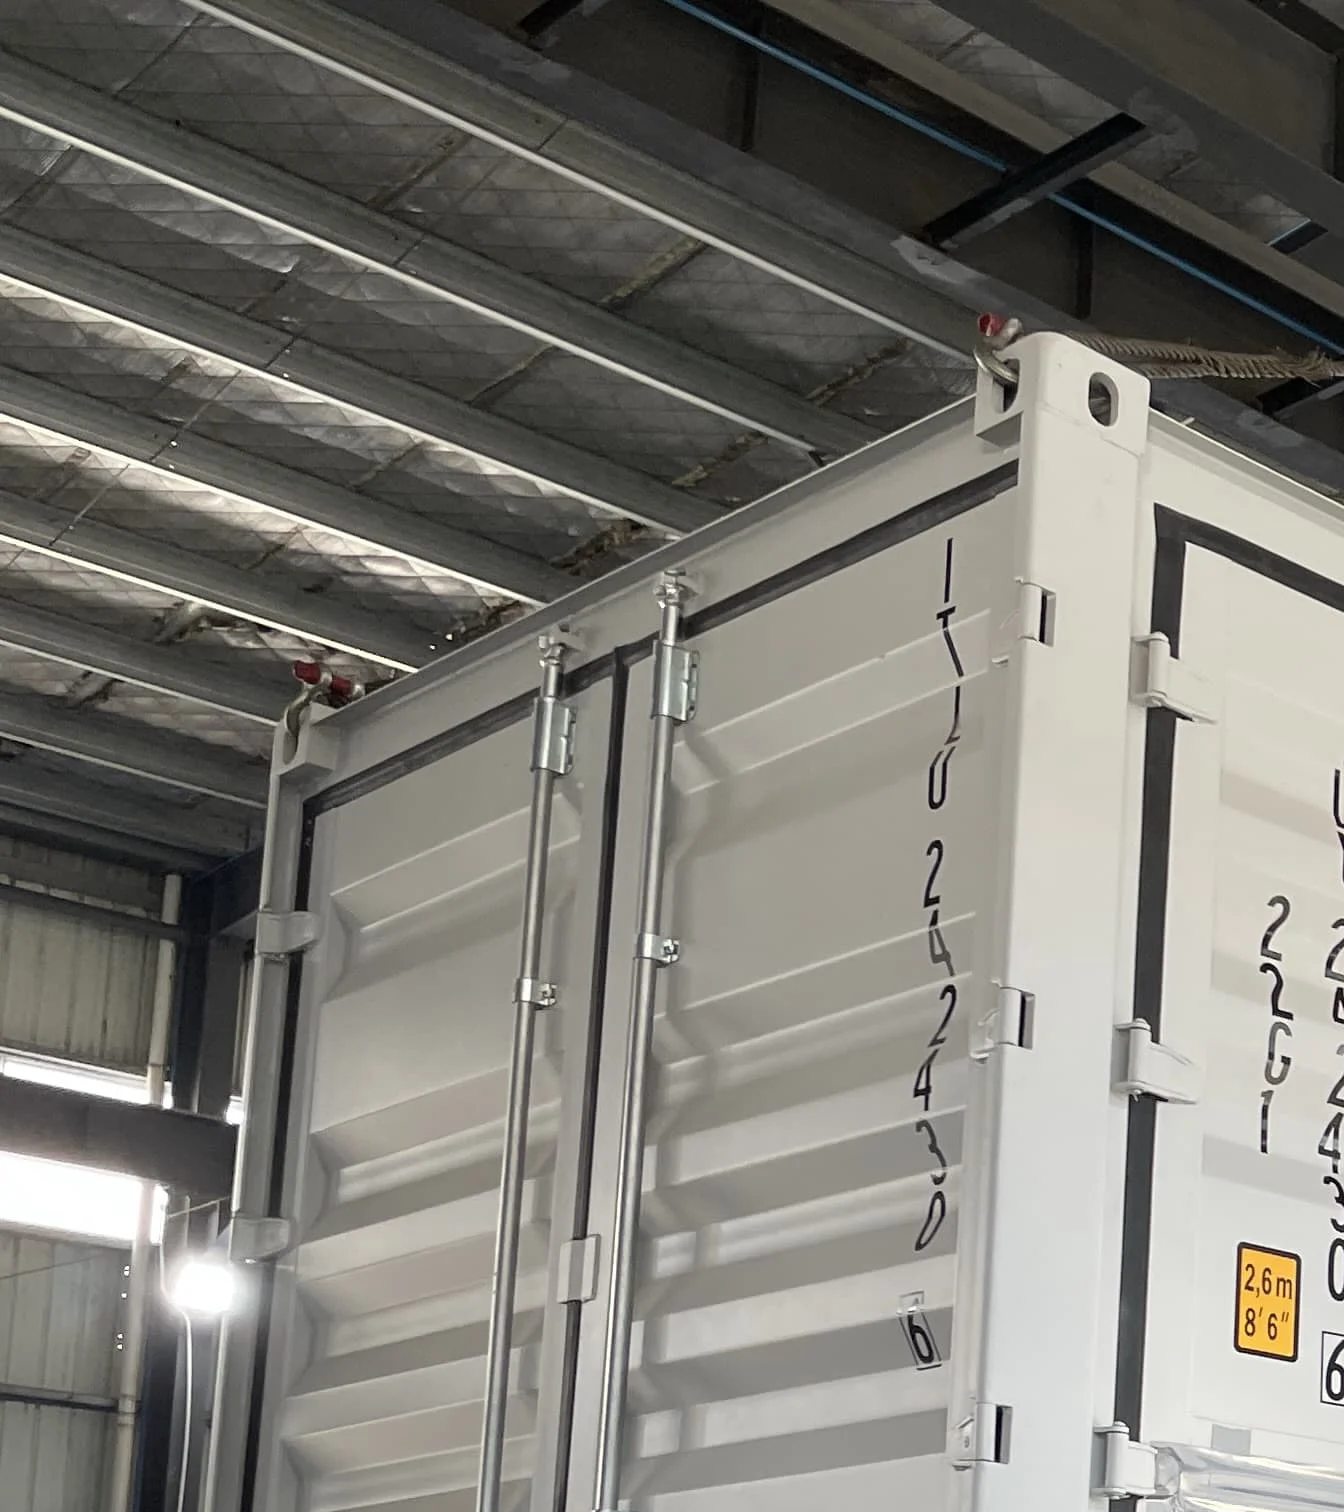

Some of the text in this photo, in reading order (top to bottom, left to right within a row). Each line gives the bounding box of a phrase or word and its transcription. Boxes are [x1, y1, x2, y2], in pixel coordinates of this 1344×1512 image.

[906, 537, 963, 1365] ITLU 242430 6
[1259, 895, 1294, 1154] 22G1
